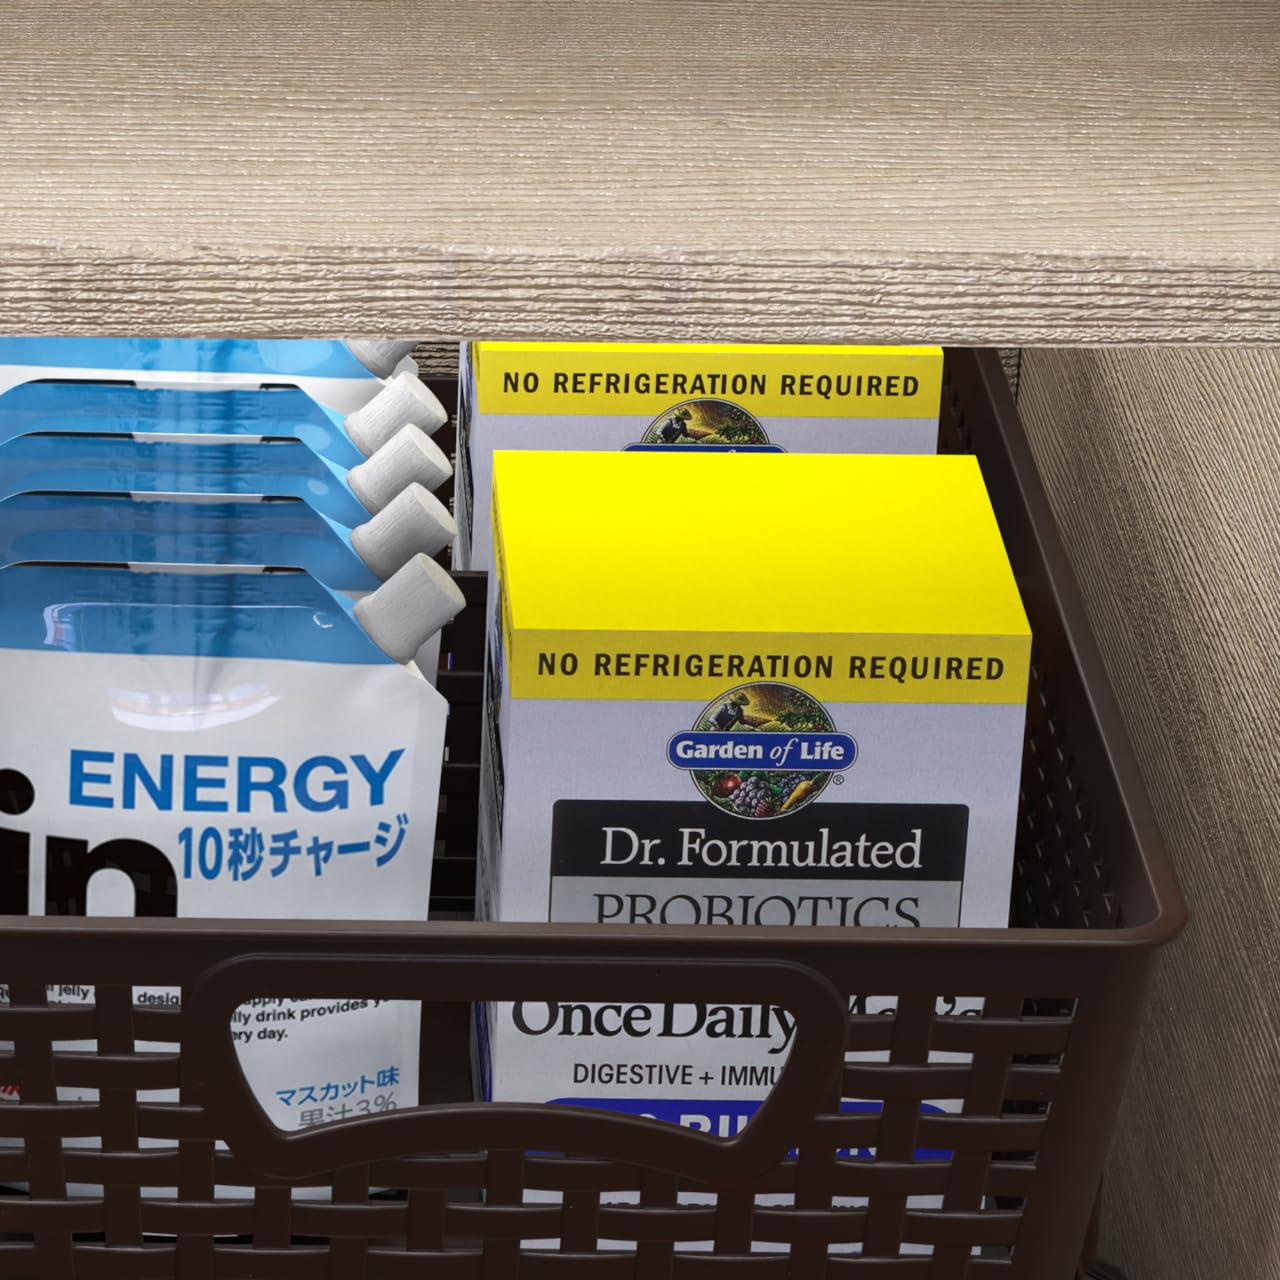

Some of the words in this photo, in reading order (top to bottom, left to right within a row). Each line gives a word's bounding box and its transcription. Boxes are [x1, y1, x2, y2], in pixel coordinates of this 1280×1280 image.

[502, 371, 539, 394] NO
[553, 371, 767, 396] REFRIGERATION
[780, 373, 920, 399] REQUIRED
[537, 652, 579, 677] NO
[593, 653, 833, 680] REFRIGERATION
[848, 655, 1005, 682] REQUIRED
[675, 740, 763, 761] Garden
[769, 737, 798, 767] of
[800, 741, 845, 761] Life
[68, 747, 406, 814] ENERGY
[178, 813, 409, 882] 10秒チャージ
[600, 826, 665, 866] Dr.
[677, 826, 922, 869] Formulated
[255, 1009, 296, 1023] drink
[300, 1000, 368, 1021] provides
[257, 1027, 288, 1042] day.
[512, 1001, 652, 1038] Once
[658, 1001, 799, 1053] Daily
[275, 1065, 400, 1107] マスカット味
[573, 1063, 693, 1087] DIGESTIVE
